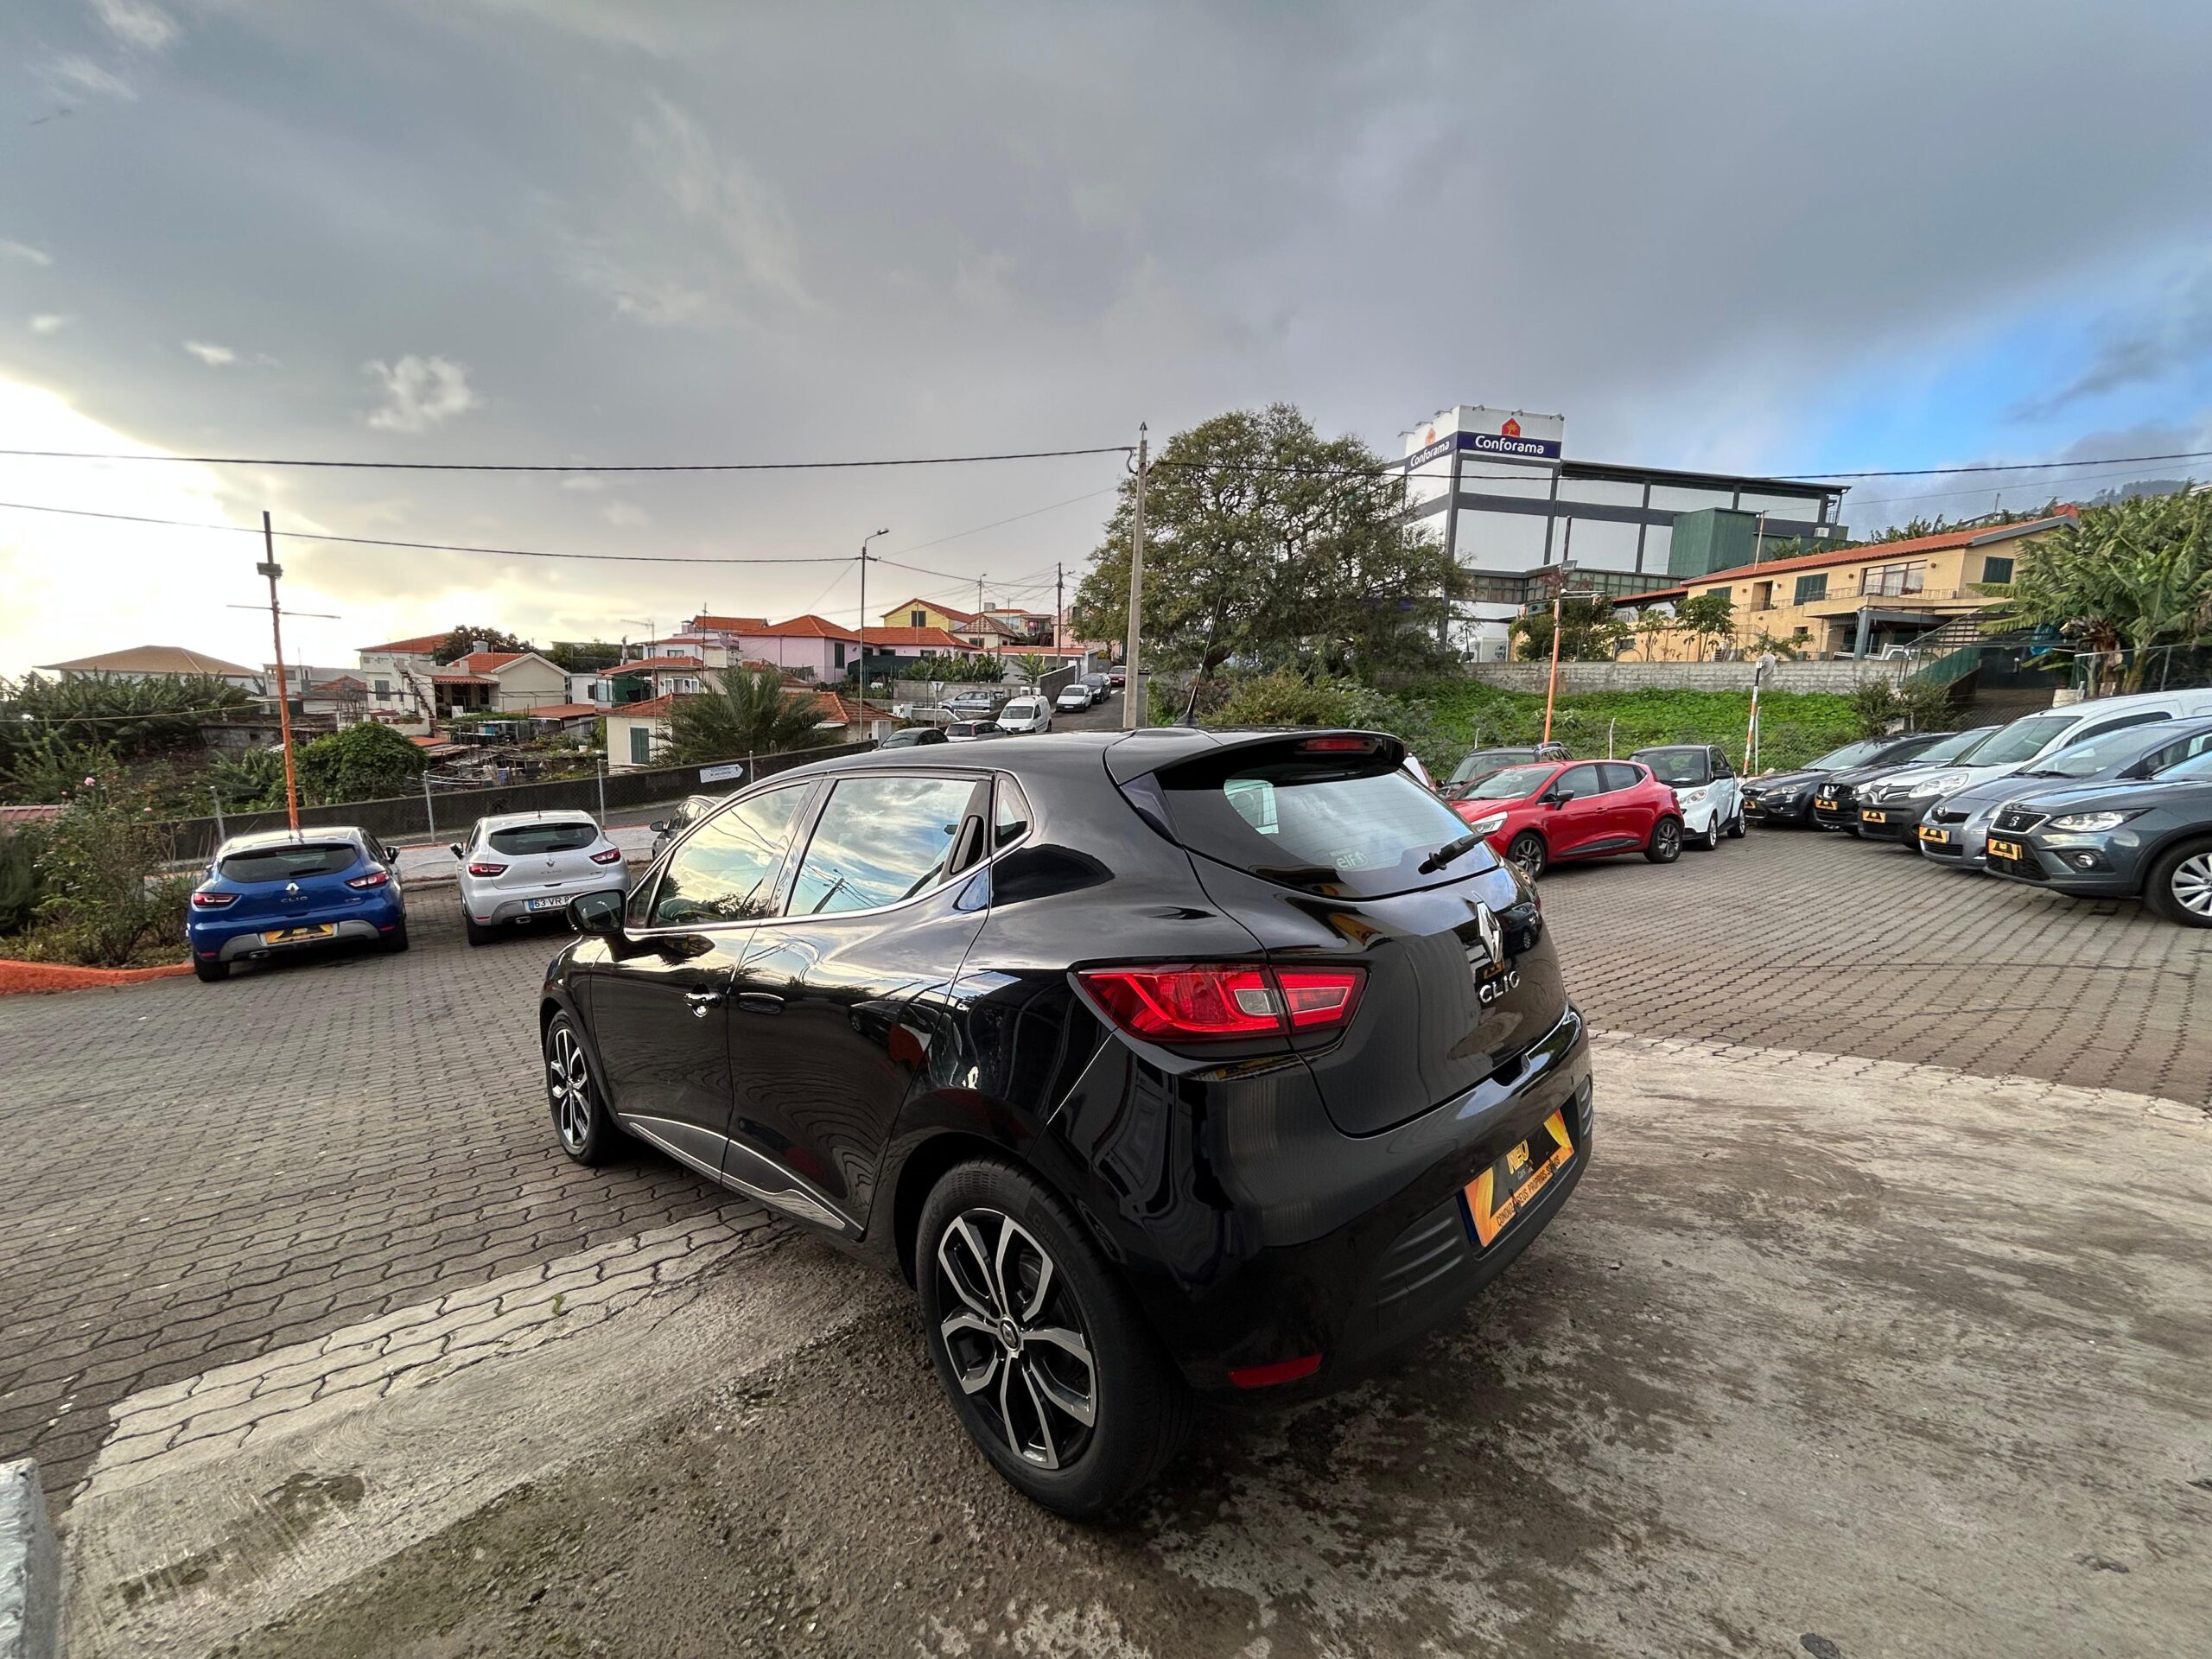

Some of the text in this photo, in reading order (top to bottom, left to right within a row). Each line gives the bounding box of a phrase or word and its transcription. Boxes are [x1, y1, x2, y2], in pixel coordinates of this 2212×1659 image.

[1410, 440, 1450, 467] Conforama
[1475, 435, 1545, 454] Conforama
[548, 897, 562, 906] VR
[1479, 970, 1520, 1003] CLIO
[1506, 1139, 1529, 1175] NEO
